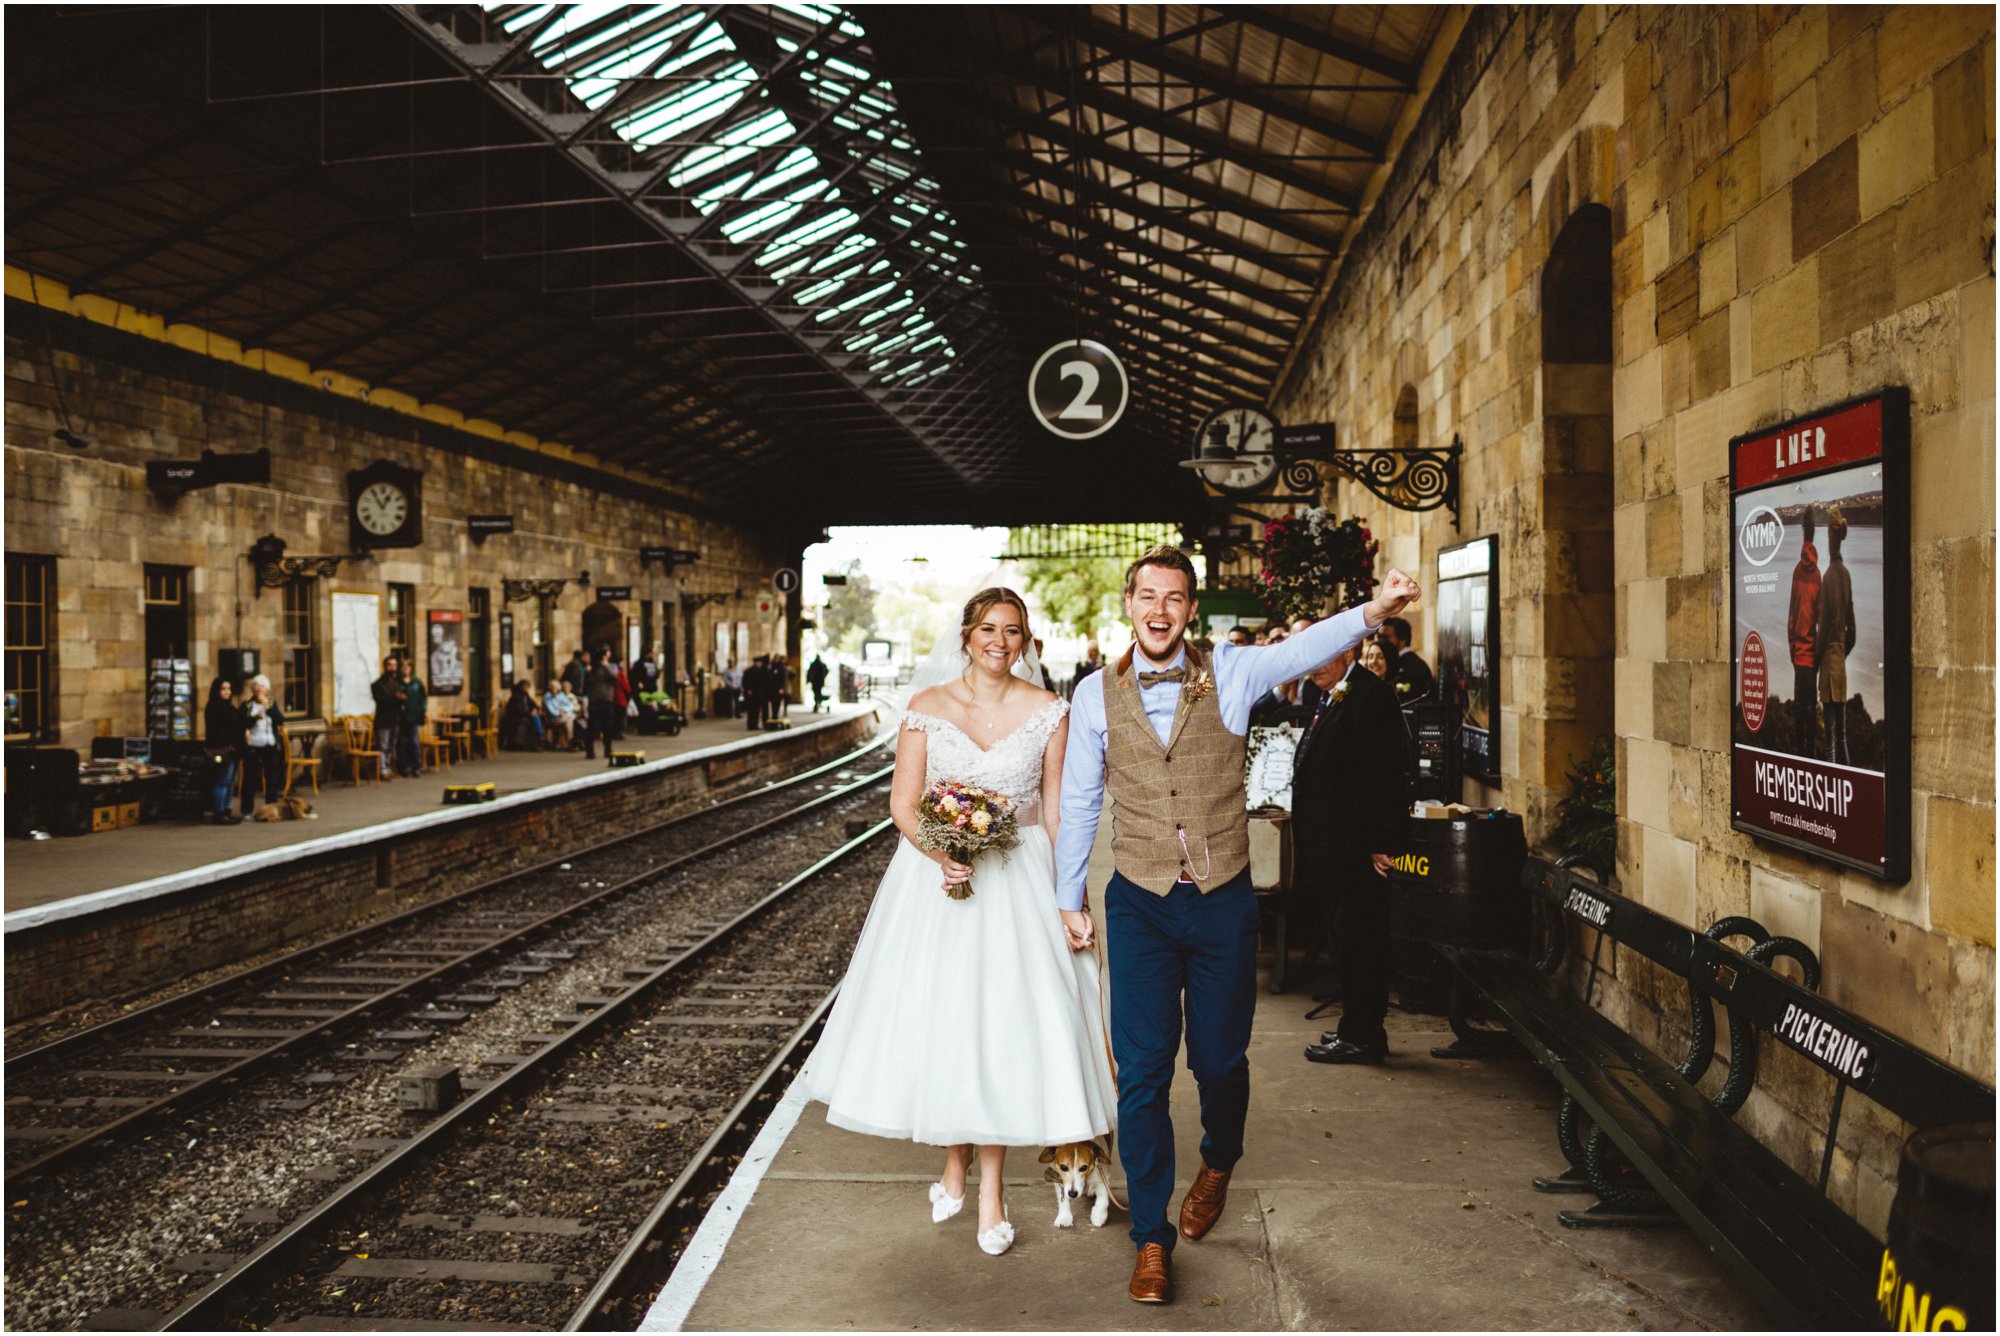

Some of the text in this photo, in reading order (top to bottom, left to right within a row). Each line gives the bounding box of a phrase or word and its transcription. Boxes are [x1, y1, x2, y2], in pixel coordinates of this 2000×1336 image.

[1058, 360, 1104, 419] 2
[1776, 426, 1826, 469] LNER
[166, 468, 194, 478] SHOP
[1746, 521, 1776, 549] NYMR
[1744, 574, 1757, 583] NORTH
[1746, 584, 1758, 594] MOORS
[1755, 759, 1853, 817] MEMBERSHIP
[1769, 810, 1837, 844] nymr.co.uk/membership
[1566, 888, 1610, 926] PICKERING
[1780, 1003, 1868, 1079] PICKERING
